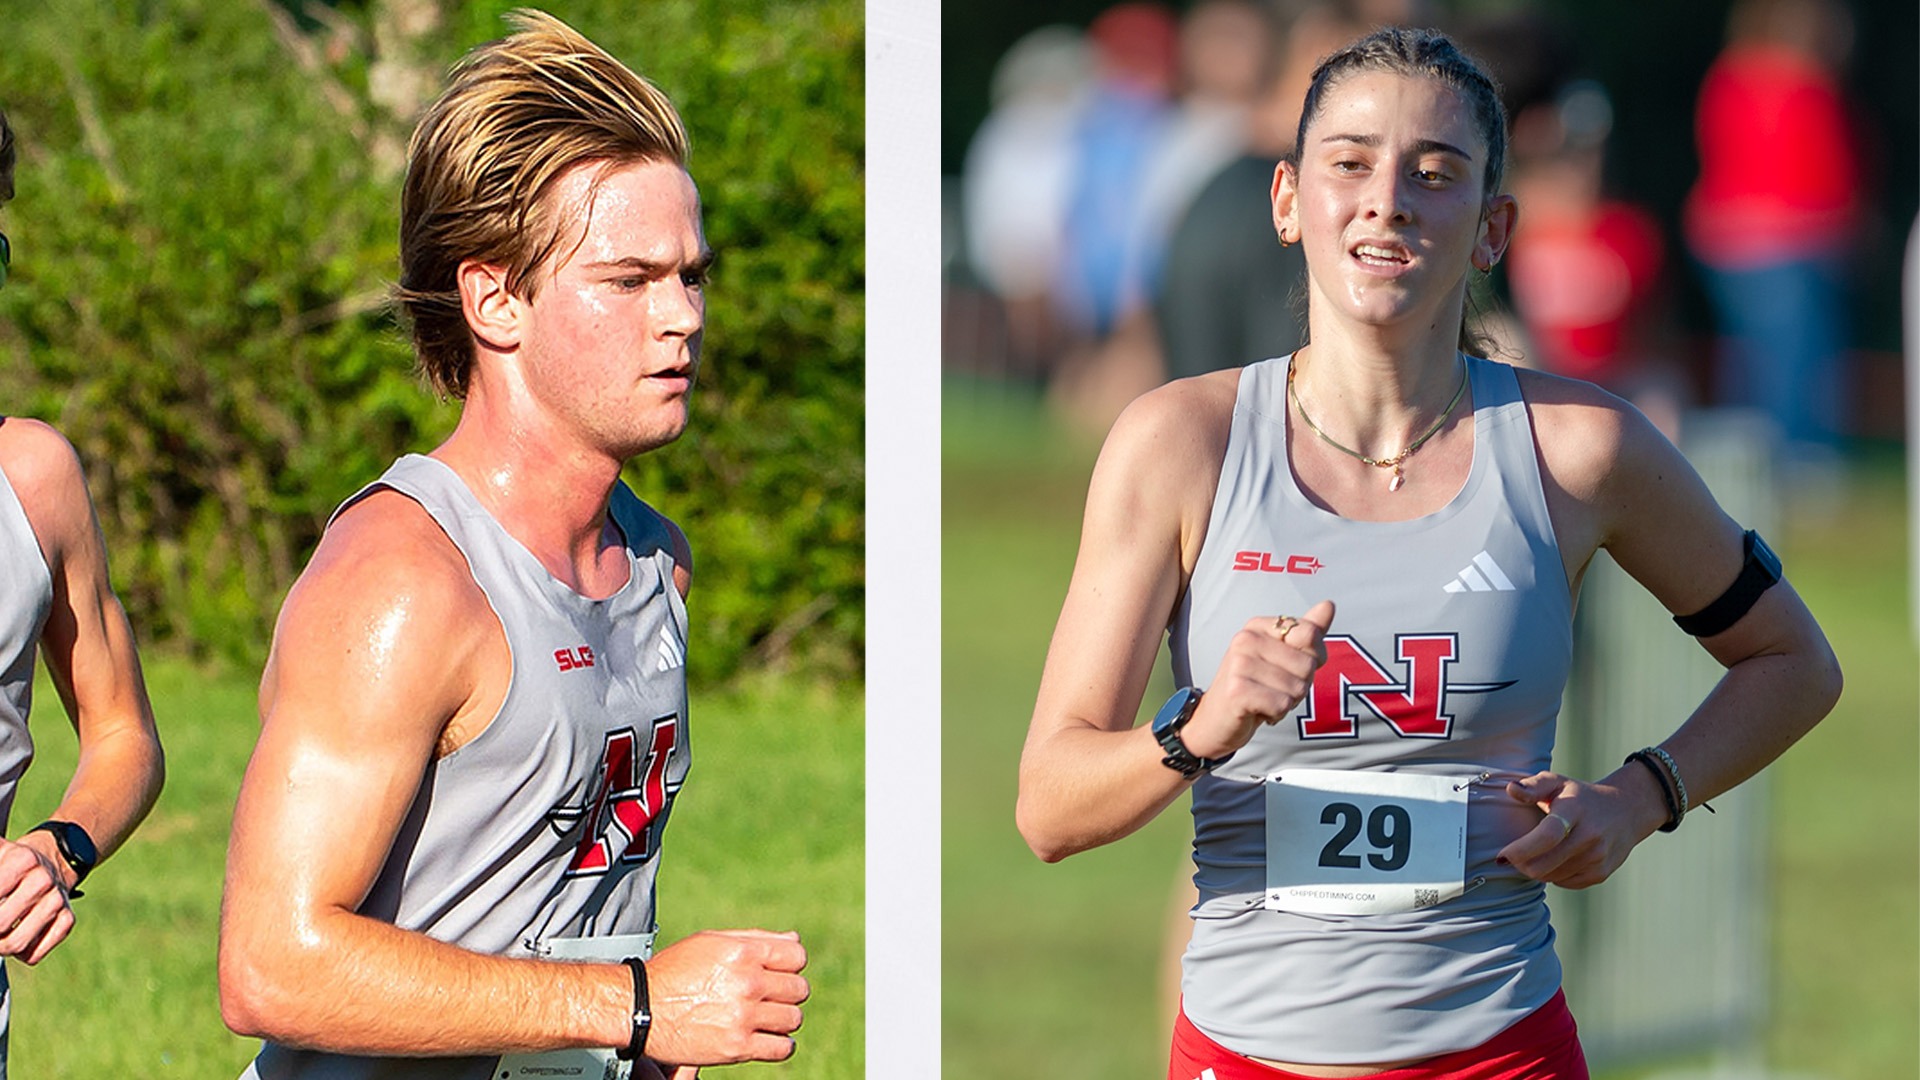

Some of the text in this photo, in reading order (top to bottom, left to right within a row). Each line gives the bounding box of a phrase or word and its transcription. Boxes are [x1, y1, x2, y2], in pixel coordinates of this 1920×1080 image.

[1233, 551, 1321, 575] SLC
[554, 646, 594, 672] SLC
[1296, 632, 1459, 740] N
[563, 713, 678, 879] N
[1318, 802, 1412, 871] 29
[1290, 889, 1376, 901] CHIPPEDTIMING.COM
